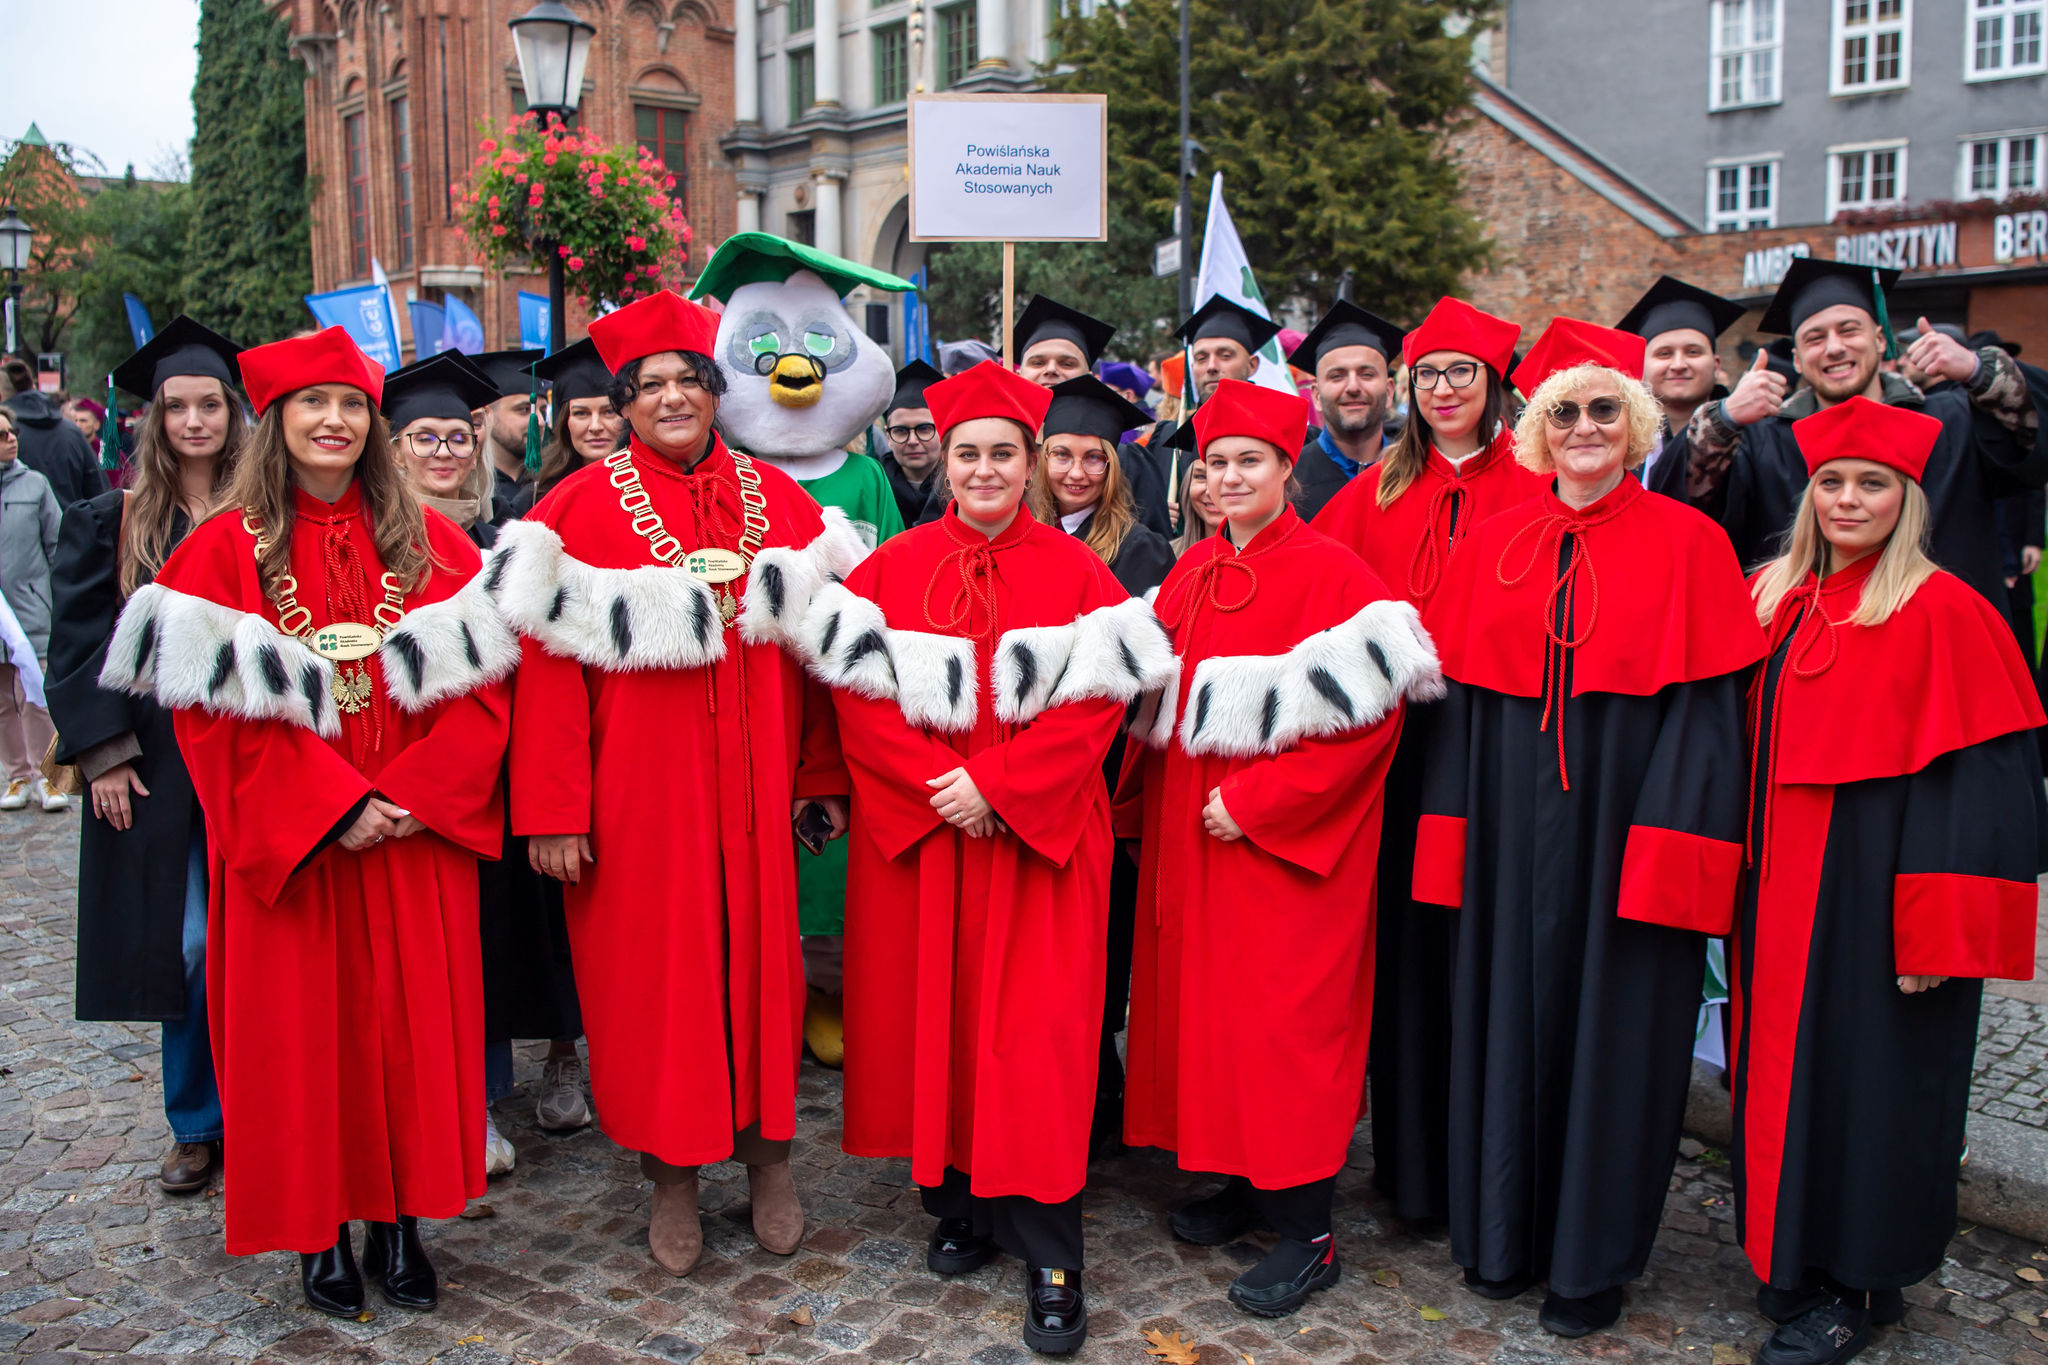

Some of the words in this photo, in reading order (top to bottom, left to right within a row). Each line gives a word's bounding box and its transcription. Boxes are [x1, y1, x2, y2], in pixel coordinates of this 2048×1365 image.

[967, 144, 1050, 157] Powiślańska
[955, 163, 1021, 175] Akademia
[1026, 163, 1061, 176] Nauk
[964, 181, 1053, 197] Stosowanych
[1835, 221, 1957, 270] BURSZTYN
